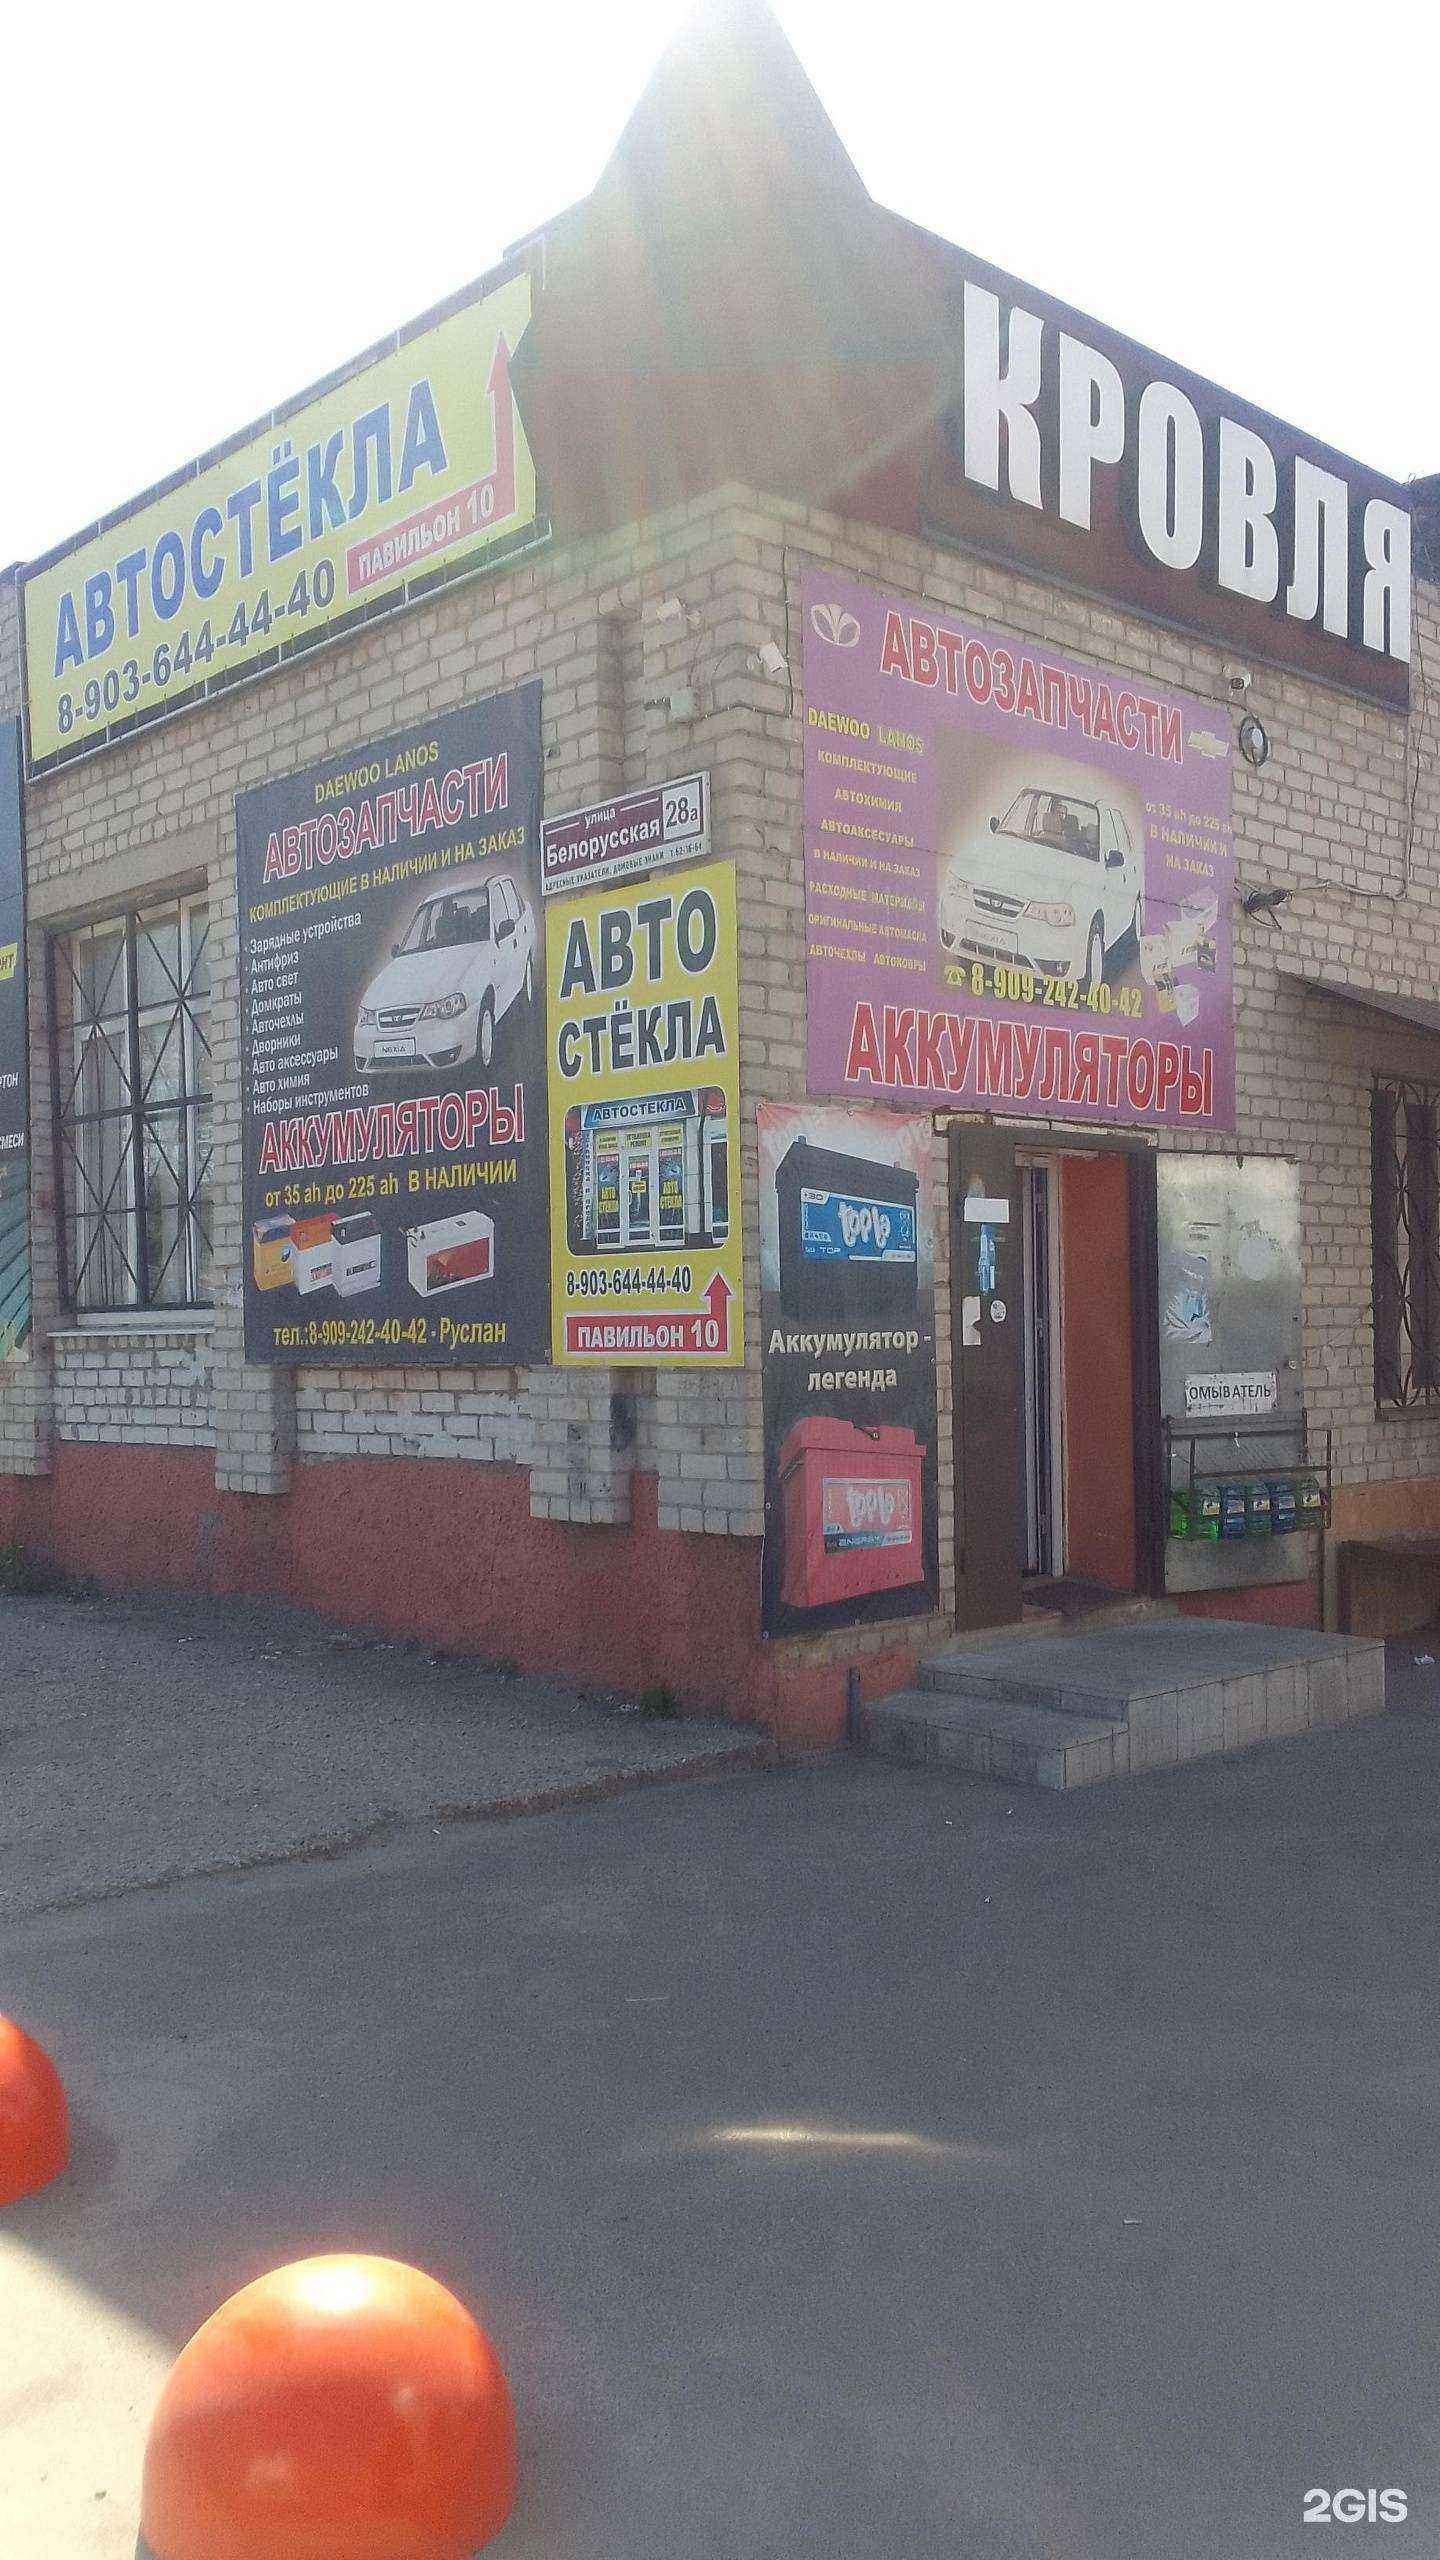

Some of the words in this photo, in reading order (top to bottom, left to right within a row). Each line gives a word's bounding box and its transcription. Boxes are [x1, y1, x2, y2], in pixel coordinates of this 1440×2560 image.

[964, 280, 1411, 663] КРОВЛЯ
[53, 377, 447, 678] АВТОСТЁКЛА
[359, 505, 461, 580] ПАВИЛЬОН
[467, 483, 495, 525] 10
[58, 558, 336, 735] 8-903-644-44-40
[879, 610, 1185, 764] АВТОЗАПЧАСТИ
[808, 706, 871, 740] DAEWOO
[879, 725, 924, 753] LANOS
[314, 763, 380, 804] DAEWOO
[385, 741, 439, 778] LANOS
[263, 751, 509, 884] АВТОЗАПЧАСТИ
[584, 807, 617, 829] улица
[546, 817, 661, 867] Белорусская
[249, 876, 357, 924] КОМПЛЕКТУЮЩИЕ
[360, 872, 370, 890] В
[372, 851, 437, 888] НАЛИЧИИ
[455, 840, 475, 863] НА
[478, 826, 527, 858] ЗАКАЗ
[250, 929, 300, 954] Зарядные
[302, 912, 362, 944] устройства
[560, 888, 717, 998] АВТО
[251, 950, 299, 974] Антифриз
[251, 978, 274, 996] Авто
[276, 971, 300, 988] свет
[971, 962, 1144, 1018] 8-909-242-40-42
[251, 991, 302, 1019] Домкраты
[251, 1012, 304, 1035] Авточехлы
[251, 1033, 301, 1058] Дворники
[558, 995, 726, 1078] СТЁКЛА
[252, 1059, 276, 1075] Авто
[278, 1046, 338, 1070] аксессуары
[844, 1001, 1214, 1117] АККУМУЛЯТОРЫ
[0, 1072, 19, 1089] ТОН
[252, 1079, 276, 1095] Авто
[278, 1073, 310, 1091] химия
[253, 1097, 292, 1115] Наборы
[294, 1083, 369, 1108] инструментов
[593, 1097, 686, 1121] АВТОСТЕКЛА
[258, 1083, 525, 1174] АККУМУЛЯТОРЫ
[265, 1190, 281, 1208] от
[284, 1183, 300, 1206] 35
[304, 1183, 320, 1204] ah
[324, 1187, 344, 1206] до
[349, 1174, 375, 1198] 225
[380, 1171, 399, 1196] ah
[408, 1169, 419, 1192] В
[425, 1158, 517, 1191] НАЛИЧИИ
[566, 1265, 692, 1297] 8-903-644-44-40
[439, 1317, 507, 1349] Руслан
[577, 1323, 684, 1349] ПАВИЛЬОН
[691, 1318, 719, 1348] 10
[768, 1329, 919, 1360] Аккумулятор
[807, 1367, 897, 1392] легенда
[1189, 1384, 1271, 1400] ОМЫВАТЕЛЬ
